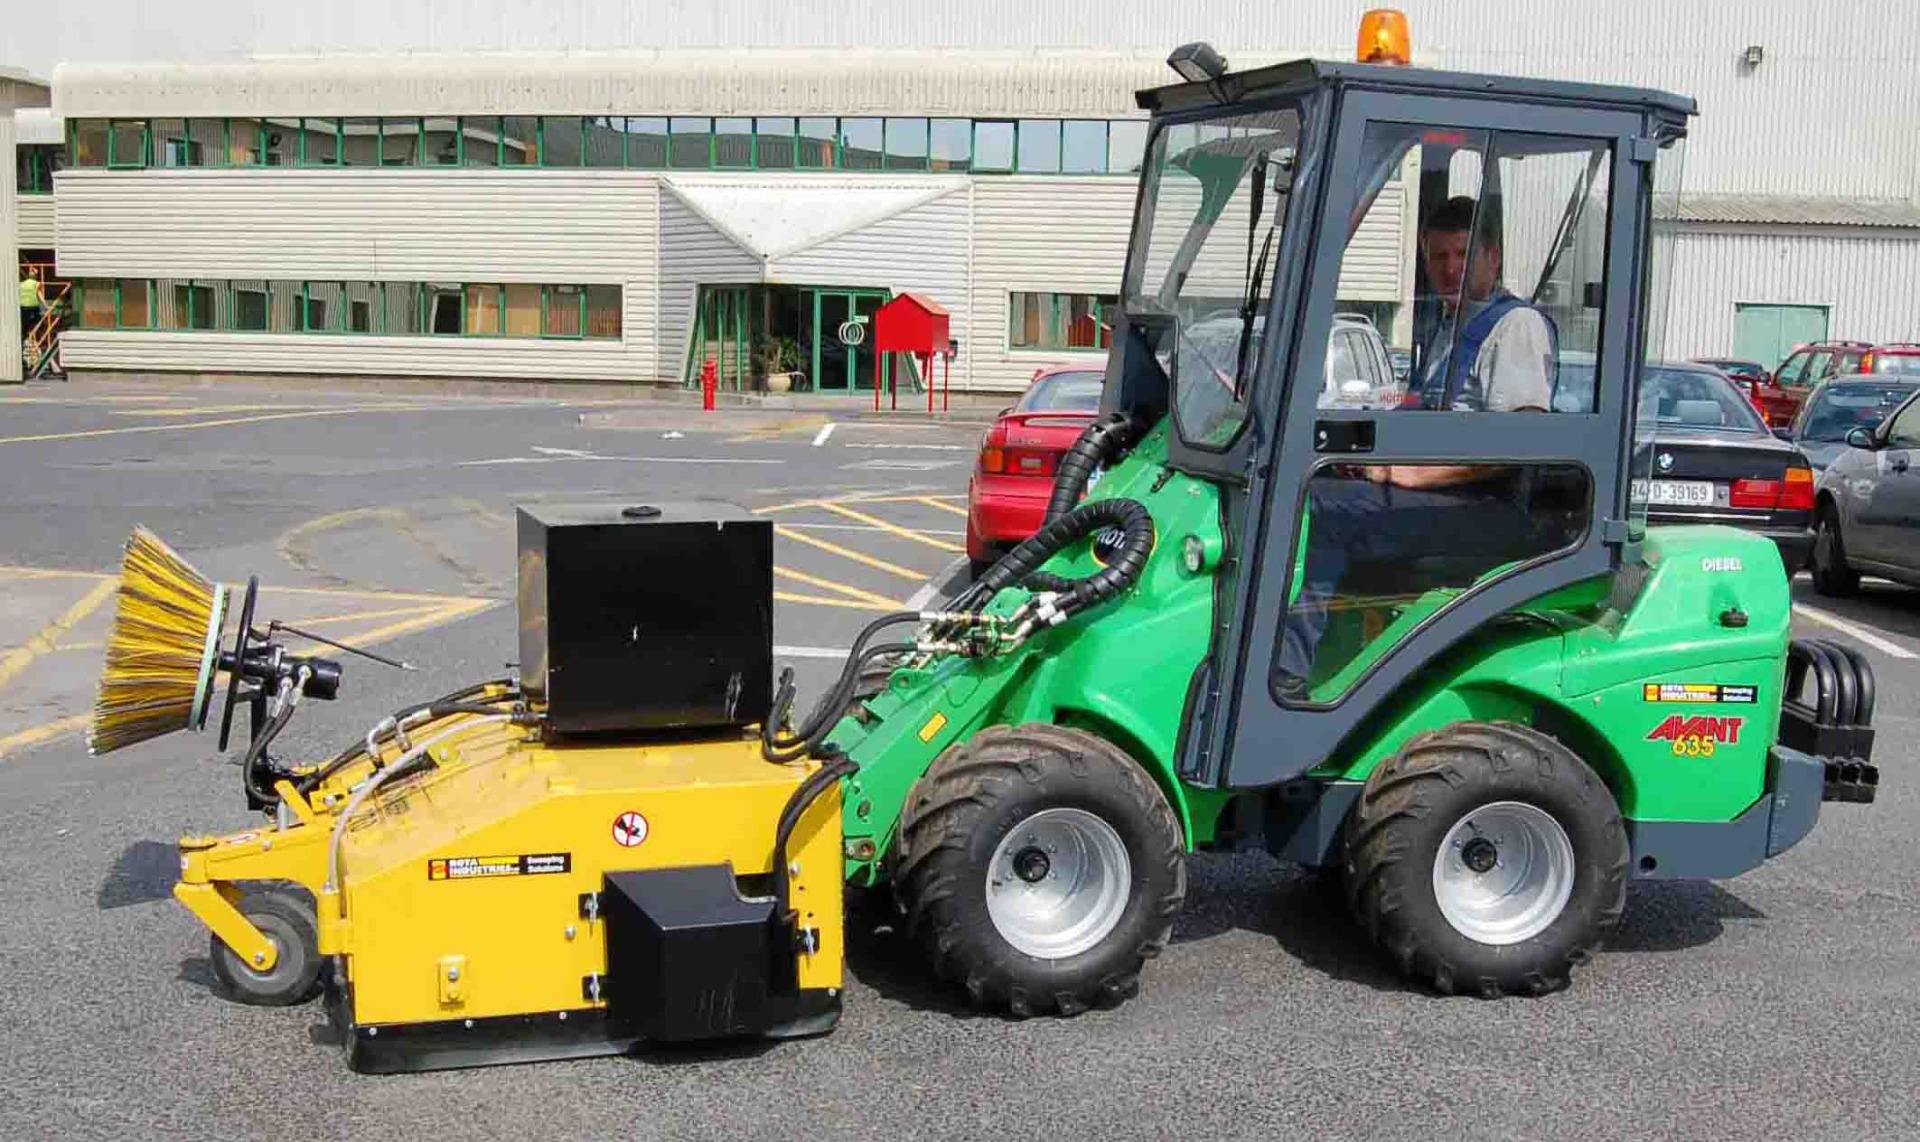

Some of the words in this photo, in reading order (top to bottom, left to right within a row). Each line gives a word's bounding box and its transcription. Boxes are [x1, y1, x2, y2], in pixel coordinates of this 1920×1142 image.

[1701, 556, 1743, 572] DIESEL
[1646, 715, 1742, 743] AVANT
[1672, 734, 1715, 757] 635
